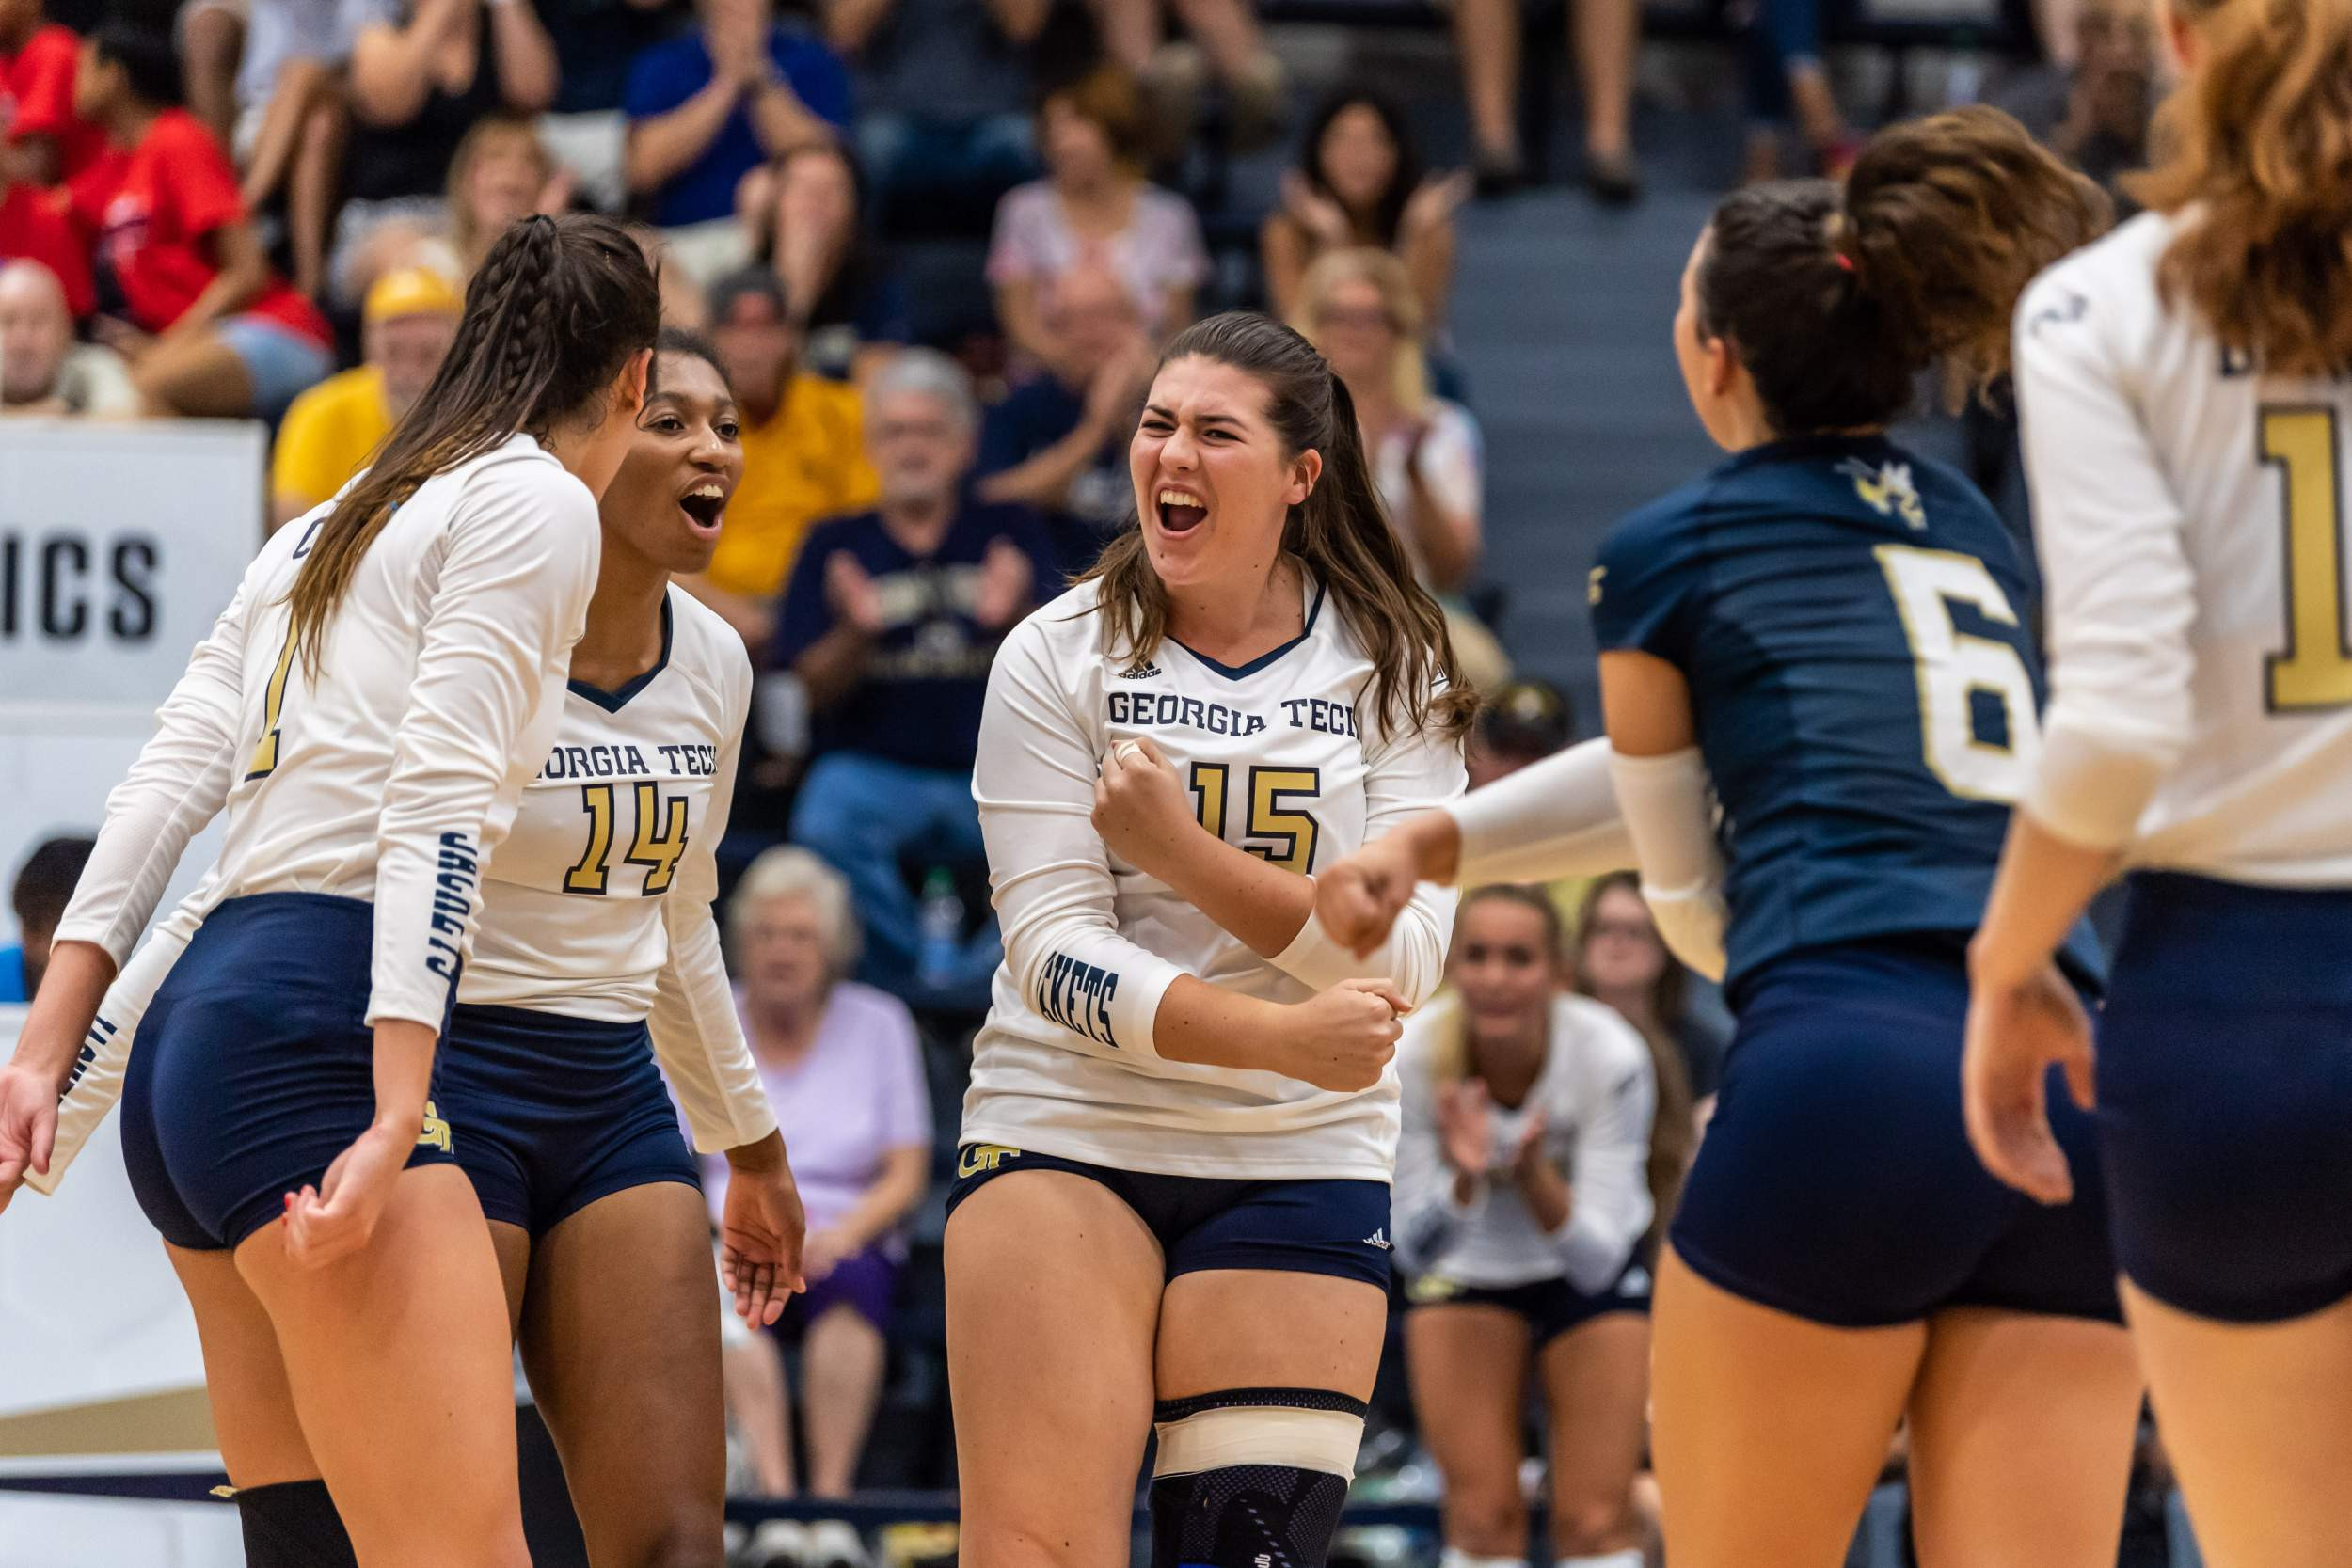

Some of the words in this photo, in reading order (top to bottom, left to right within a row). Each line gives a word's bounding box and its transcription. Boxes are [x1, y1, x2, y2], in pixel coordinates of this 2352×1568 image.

[2257, 404, 2352, 716] 1
[1108, 691, 1267, 737] GEORGIA
[1118, 667, 1162, 679] adidas
[1872, 543, 2042, 806] 6
[535, 745, 651, 779] ORGIA
[1189, 761, 1321, 875] 15
[563, 781, 689, 896] 14
